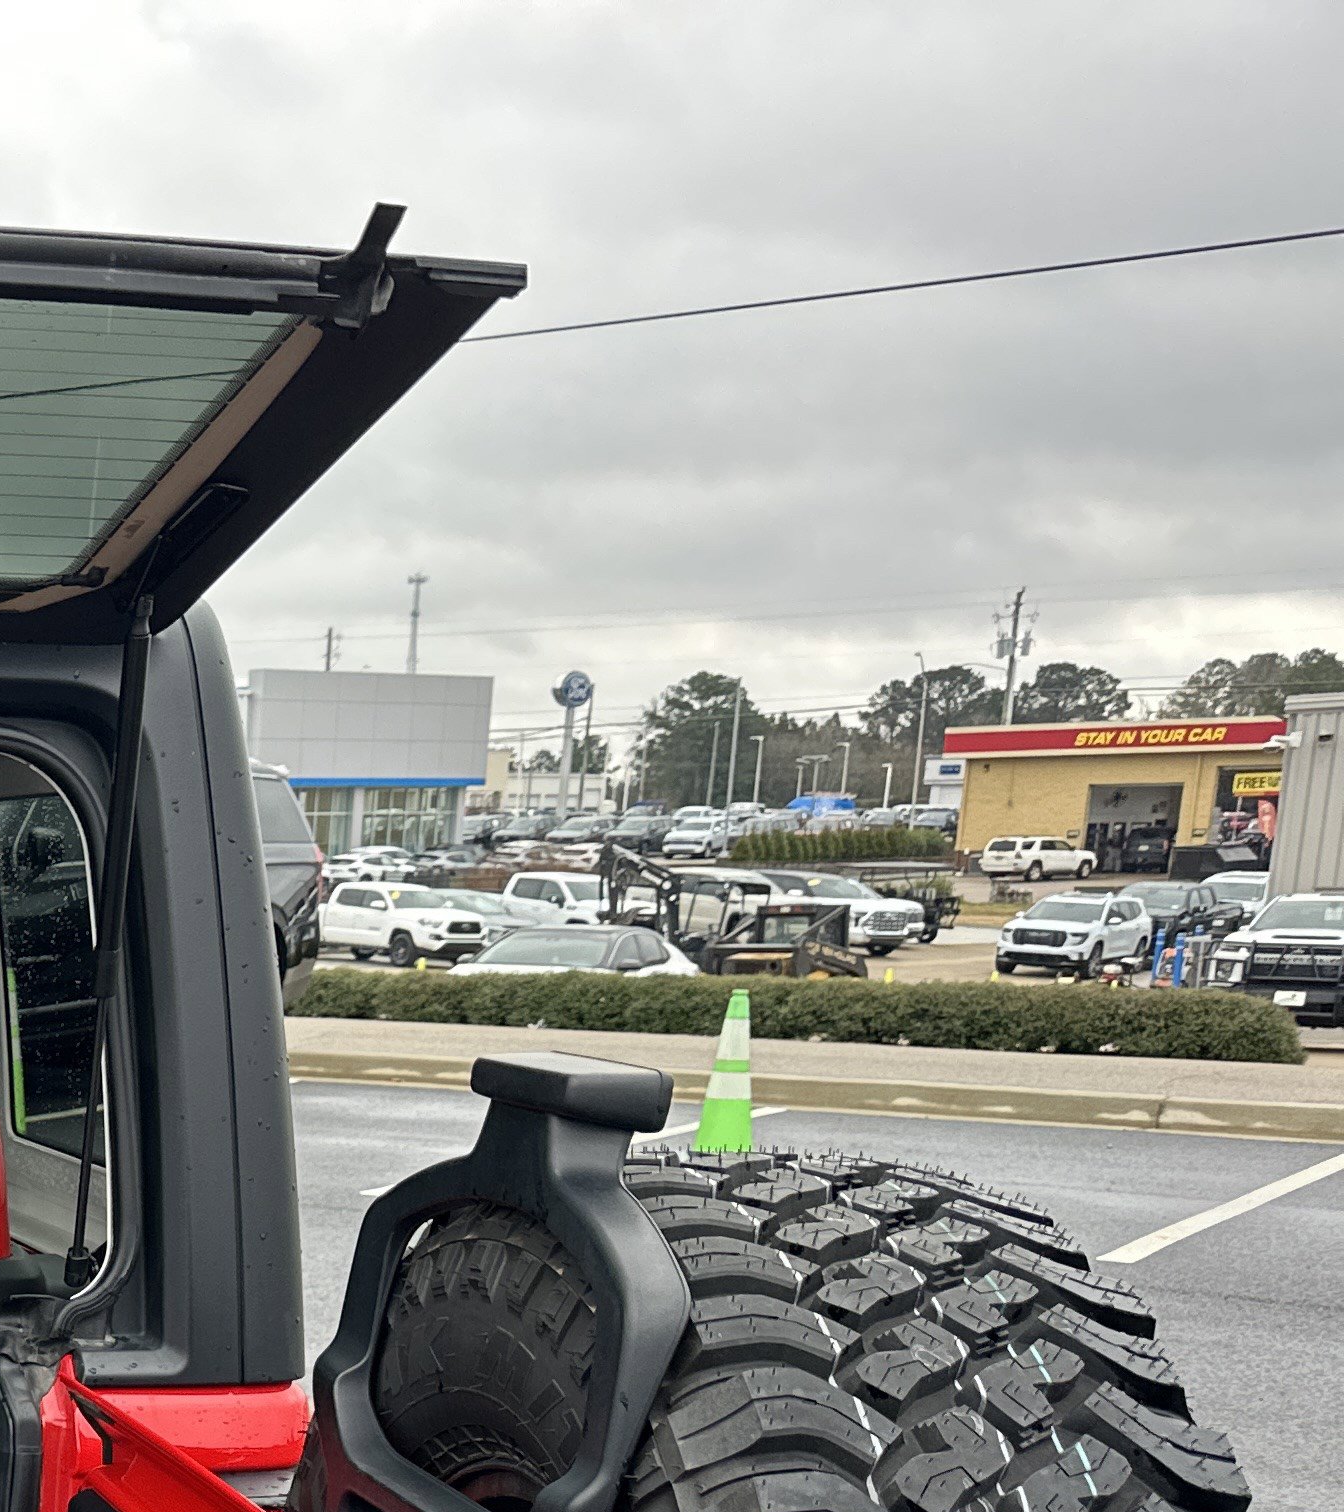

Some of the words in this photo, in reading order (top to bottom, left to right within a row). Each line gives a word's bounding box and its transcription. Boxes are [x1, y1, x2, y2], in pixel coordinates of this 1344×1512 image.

[1074, 731, 1115, 746] STAY
[1116, 730, 1138, 745] IN
[1139, 728, 1186, 744] YOUR
[1188, 727, 1228, 742] CAR
[1236, 776, 1267, 789] FREE
